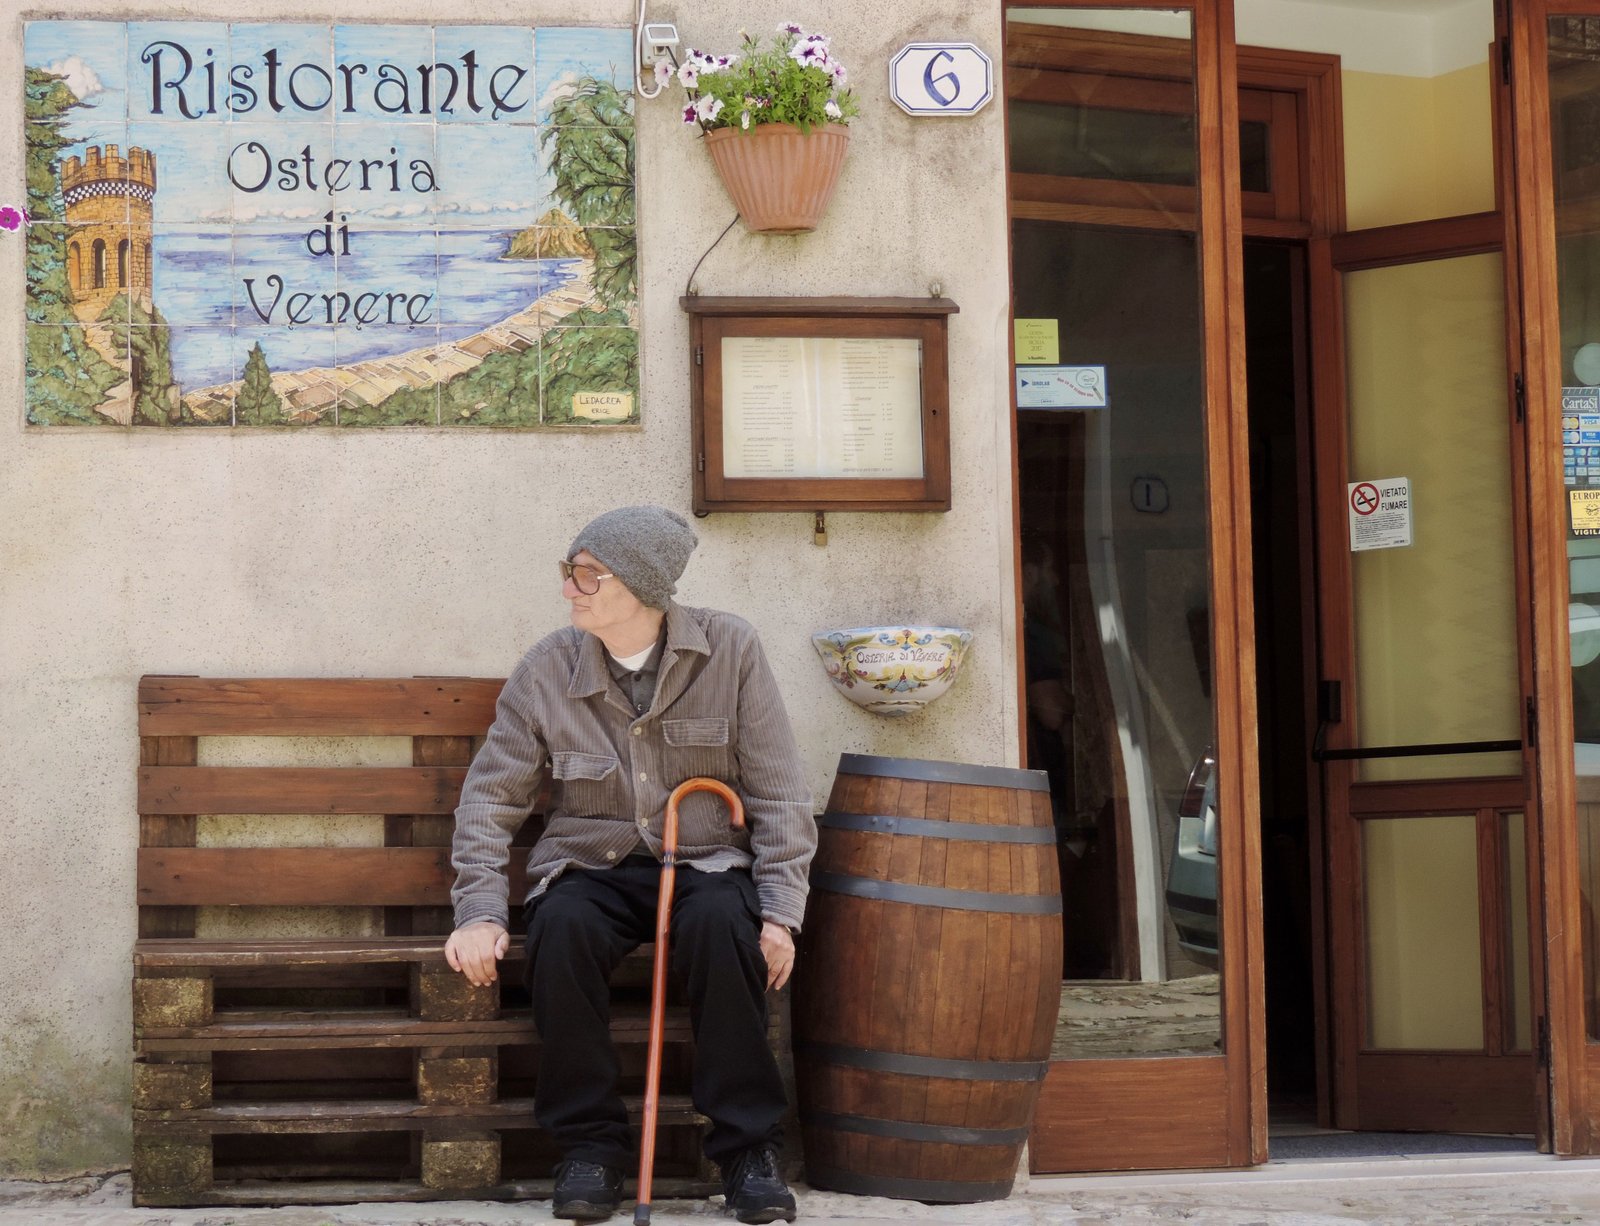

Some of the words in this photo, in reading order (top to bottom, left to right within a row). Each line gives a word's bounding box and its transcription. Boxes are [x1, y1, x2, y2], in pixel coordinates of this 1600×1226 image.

[142, 40, 529, 121] Ristorante
[923, 50, 960, 106] 6
[227, 140, 441, 195] Osteria
[307, 209, 352, 256] di
[243, 274, 433, 331] Venere
[1380, 487, 1407, 498] VIETATO
[1381, 500, 1407, 511] FUMARE
